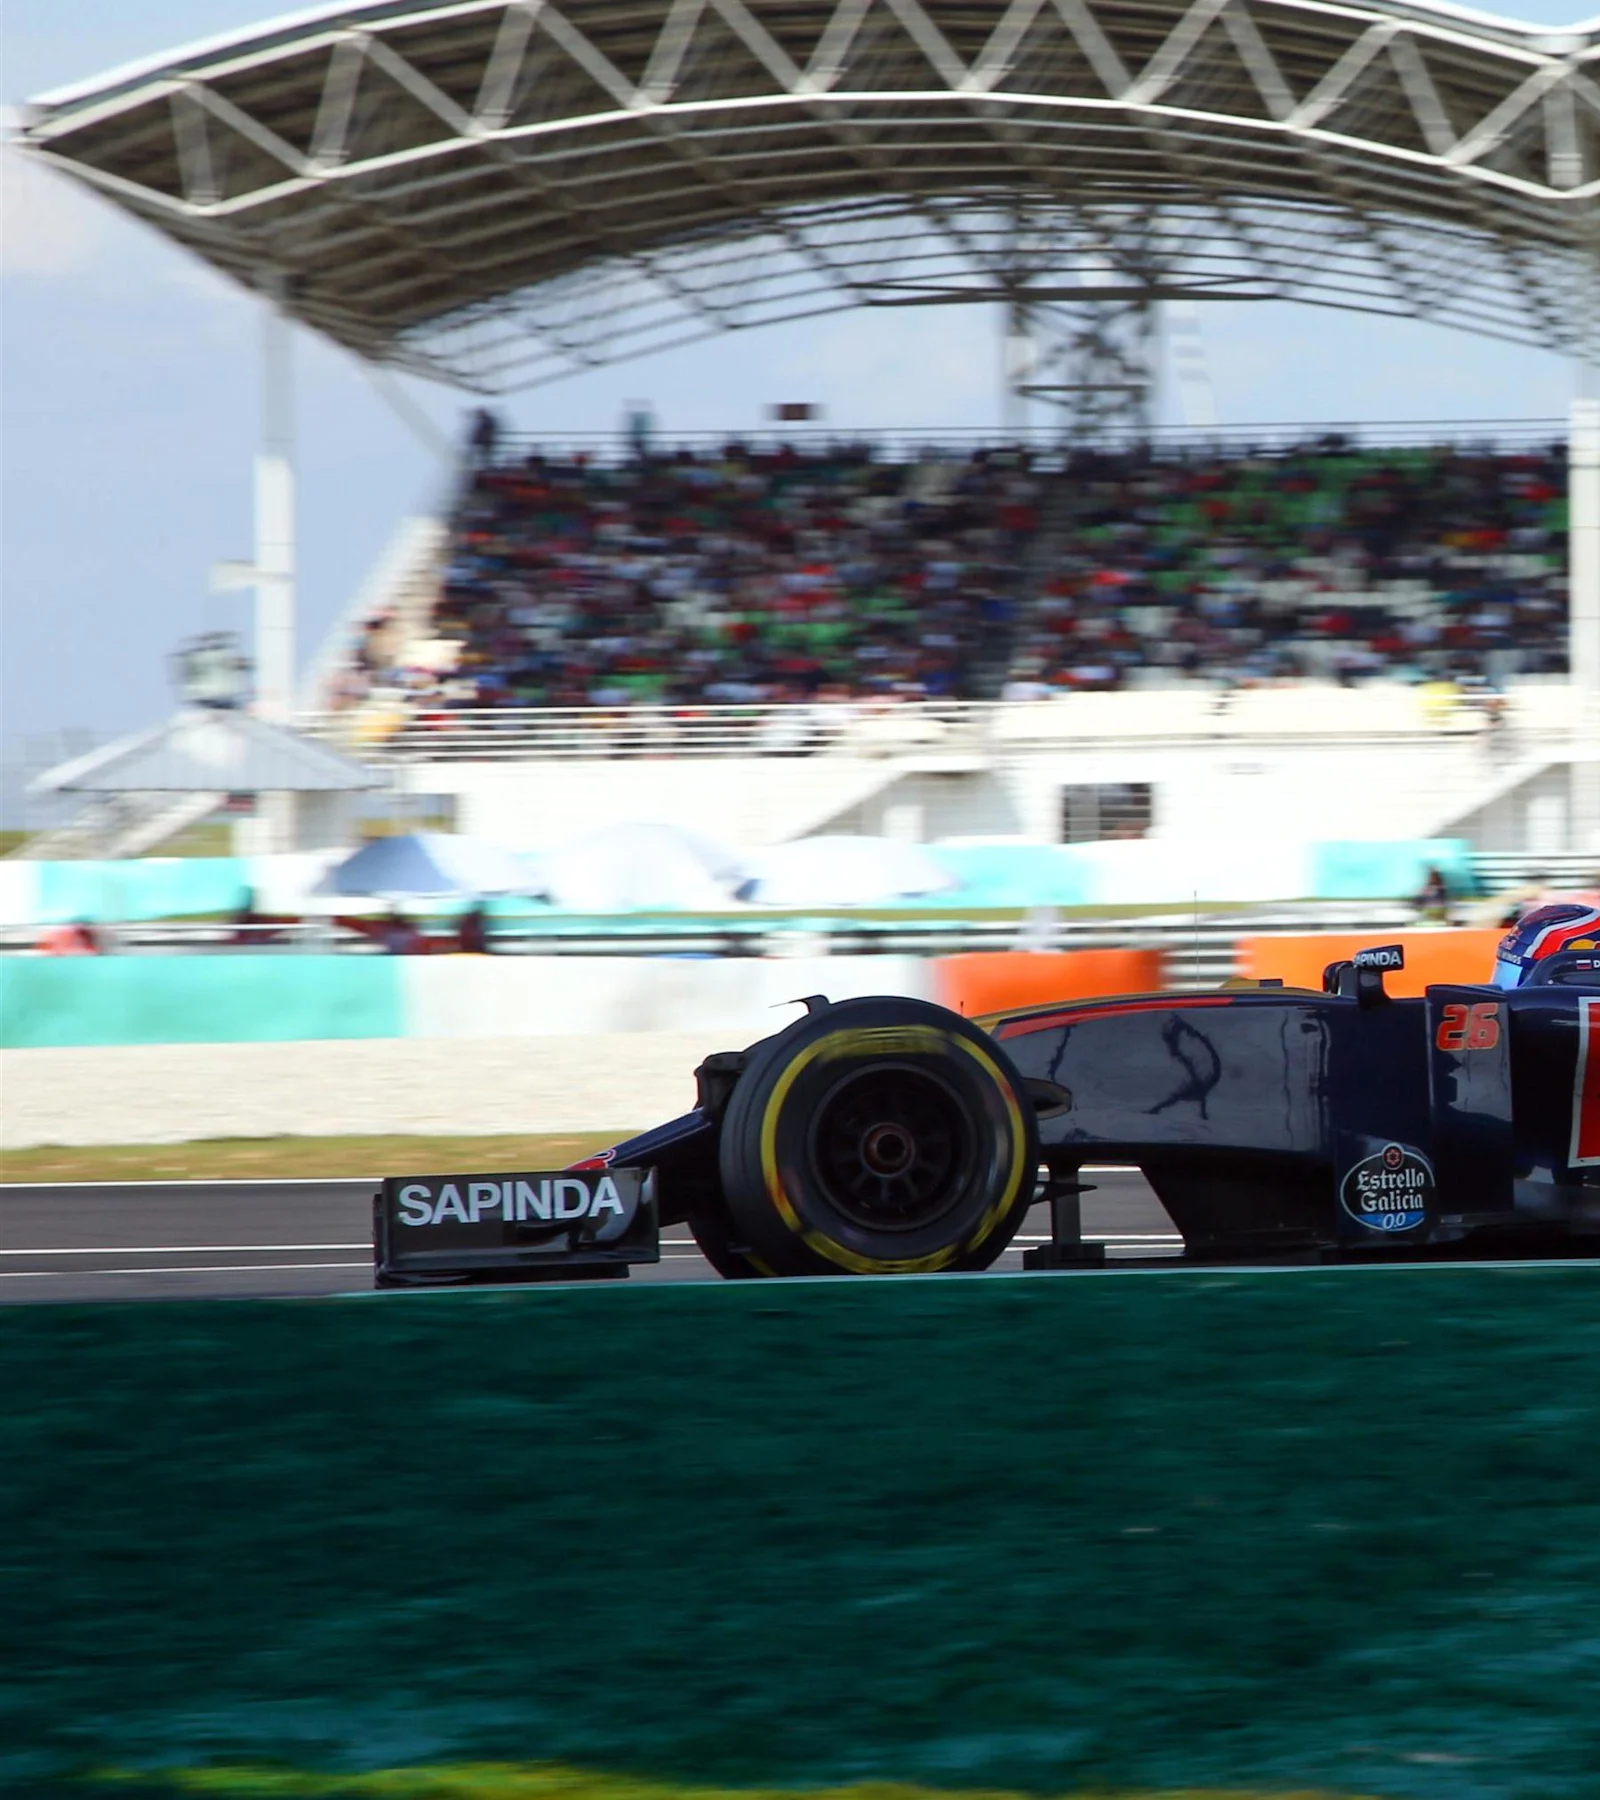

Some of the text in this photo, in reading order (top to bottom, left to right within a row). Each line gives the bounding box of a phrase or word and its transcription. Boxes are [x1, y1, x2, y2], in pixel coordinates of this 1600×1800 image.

[1436, 1002, 1500, 1051] 26
[1356, 1168, 1425, 1191] Estrella
[399, 1176, 625, 1227] SAPINDA
[1360, 1189, 1424, 1212] Galicia
